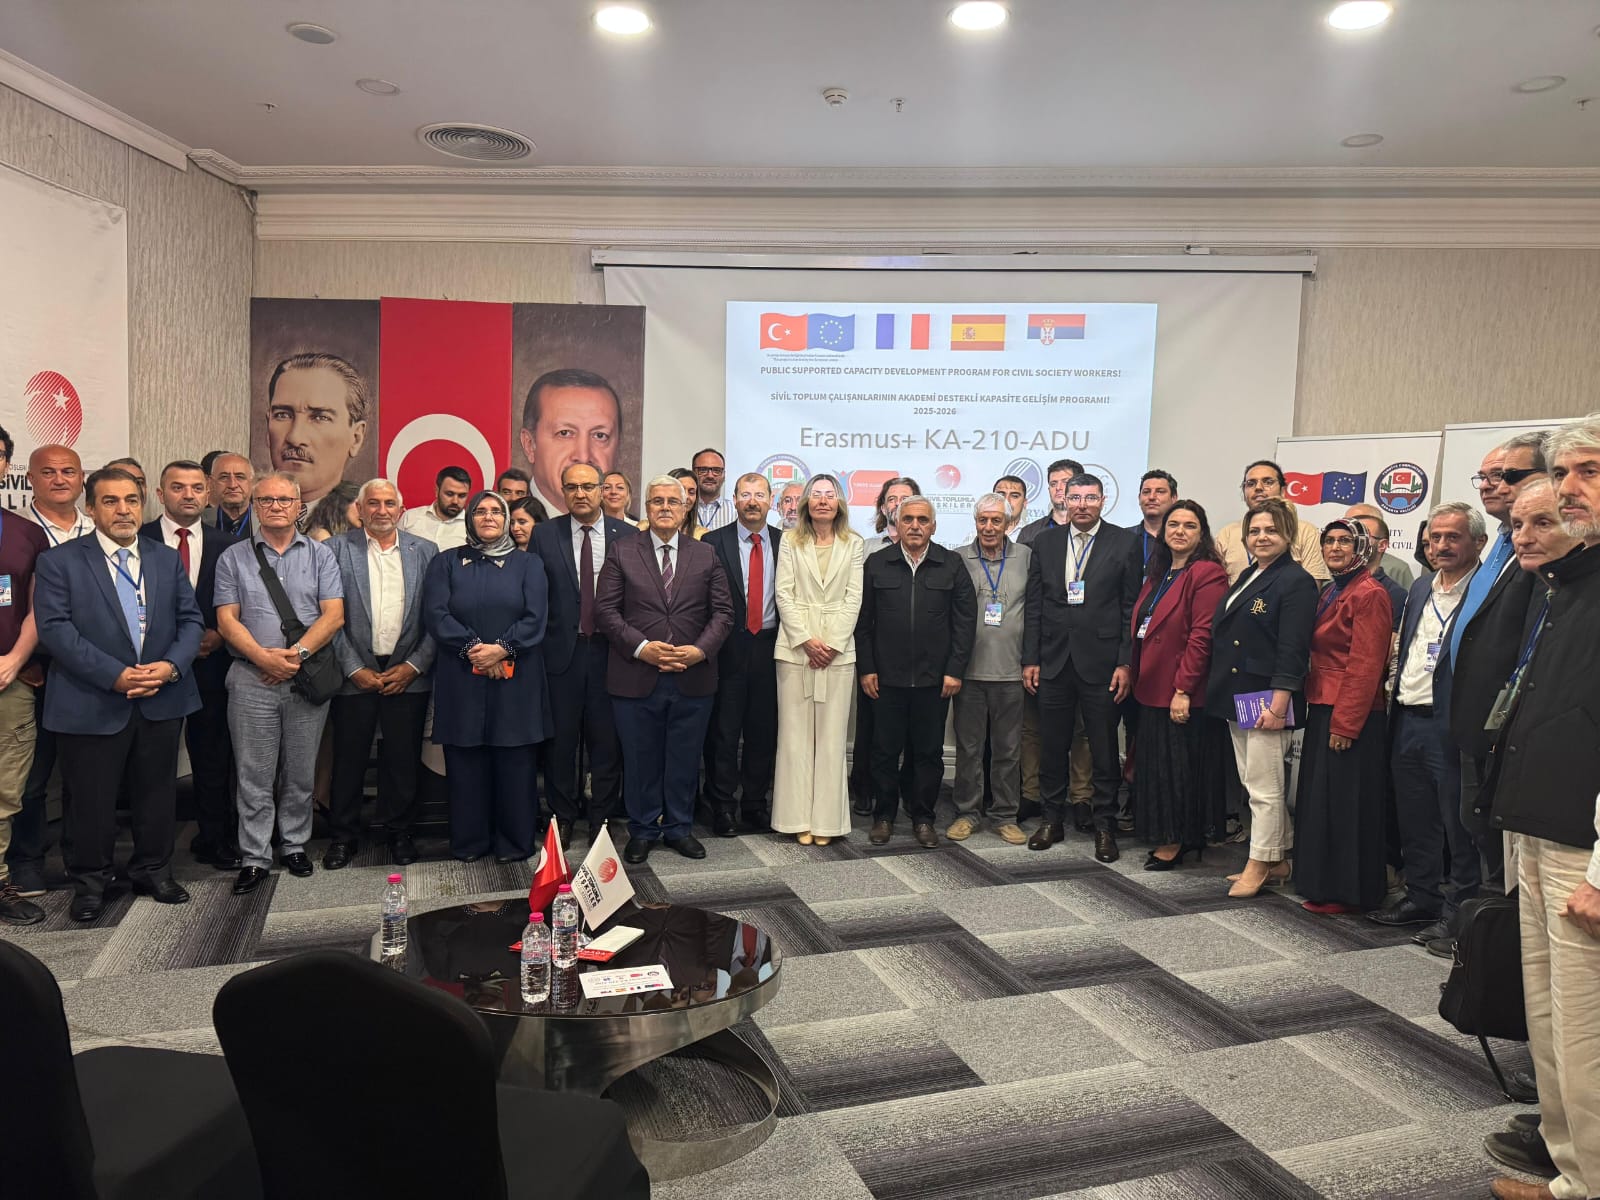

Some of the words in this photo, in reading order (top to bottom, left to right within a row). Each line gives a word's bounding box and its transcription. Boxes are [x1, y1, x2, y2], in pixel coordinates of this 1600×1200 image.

[760, 366, 791, 375] PUBLIC
[792, 366, 842, 375] SUPPORTED
[844, 367, 883, 375] CAPACITY
[884, 367, 946, 376] DEVELOPMENT
[948, 368, 991, 376] PROGRAM
[992, 368, 1010, 376] FOR
[1012, 368, 1034, 377] CIVIL
[1035, 369, 1072, 377] SOCIETY
[1073, 369, 1121, 377] WORKERS!
[770, 391, 791, 401] SİVİL
[793, 393, 827, 401] TOPLUM
[828, 393, 897, 403] ÇALIŞANLARININ
[898, 392, 936, 402] AKADEMİ
[938, 393, 978, 402] DESTEKLİ
[980, 393, 1021, 403] KAPASİTE
[1022, 394, 1058, 405] GELİŞİM
[913, 407, 957, 415] 2025-2026
[800, 427, 917, 449] Erasmus+
[925, 428, 1091, 451] KA-210-ADU
[1389, 529, 1403, 537] ITY
